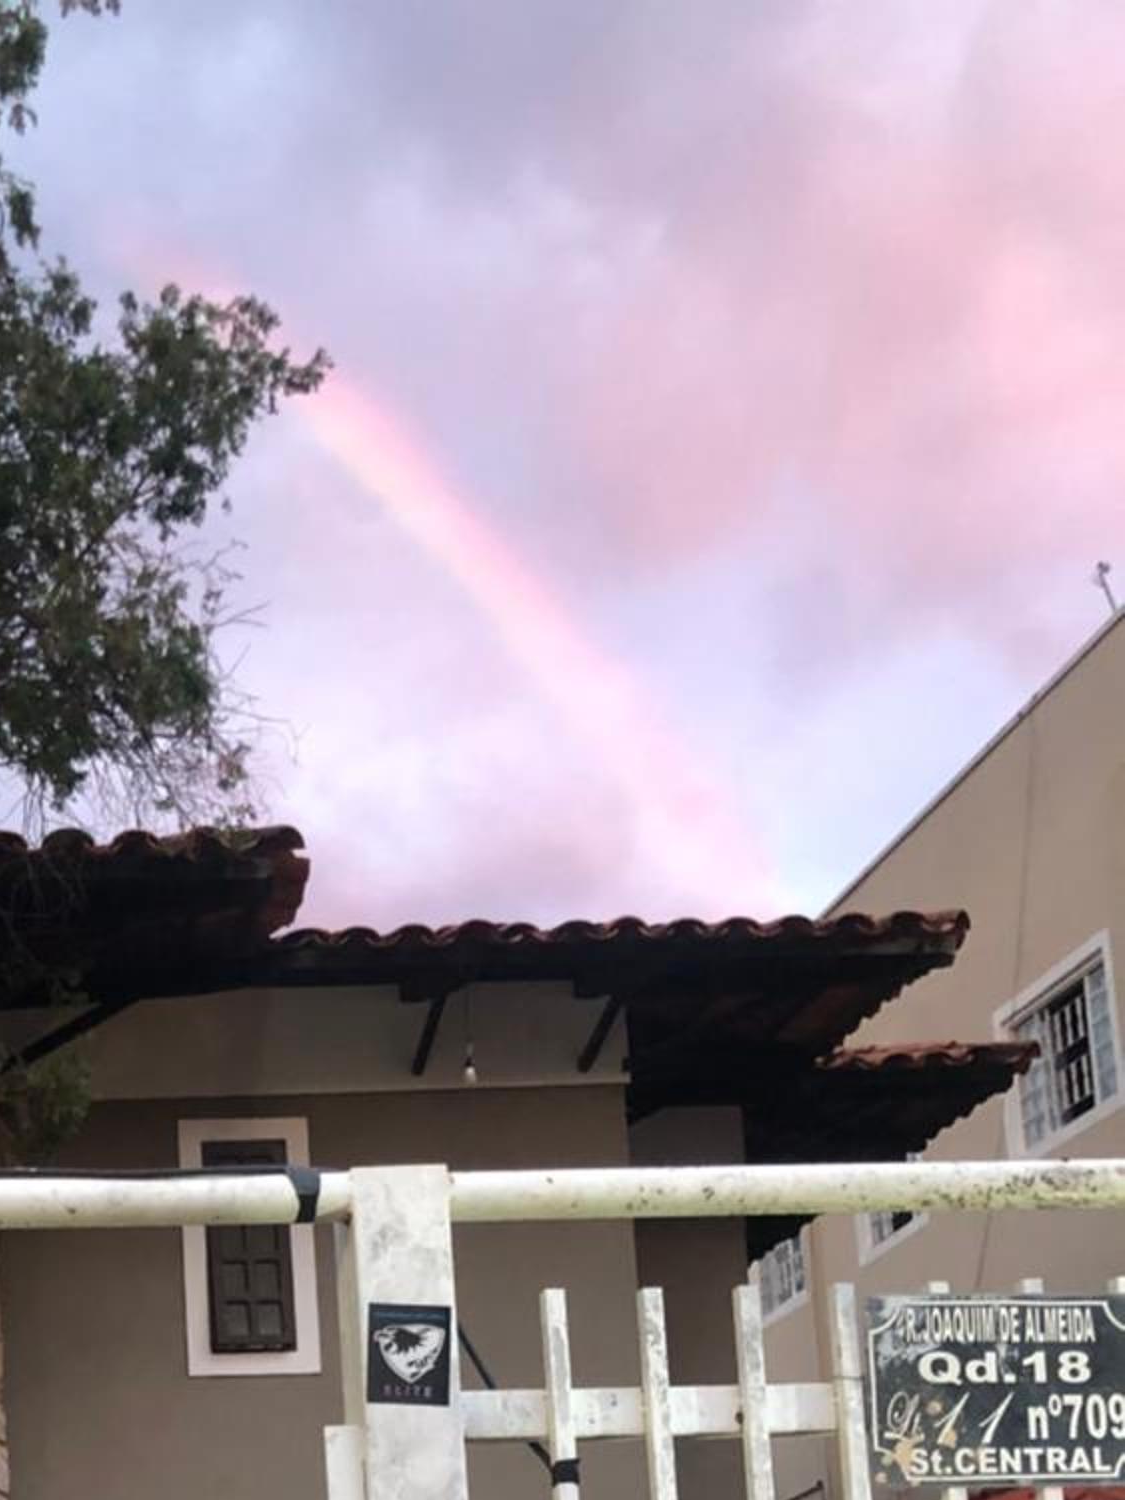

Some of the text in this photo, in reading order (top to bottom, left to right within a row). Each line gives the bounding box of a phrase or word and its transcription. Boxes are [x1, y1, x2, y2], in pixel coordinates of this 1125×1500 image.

[999, 1306, 1021, 1343] DE
[1024, 1306, 1096, 1343] ALMEIDA
[917, 1350, 1092, 1385] Qd.18
[910, 1447, 1113, 1475] St.CENTRAL
